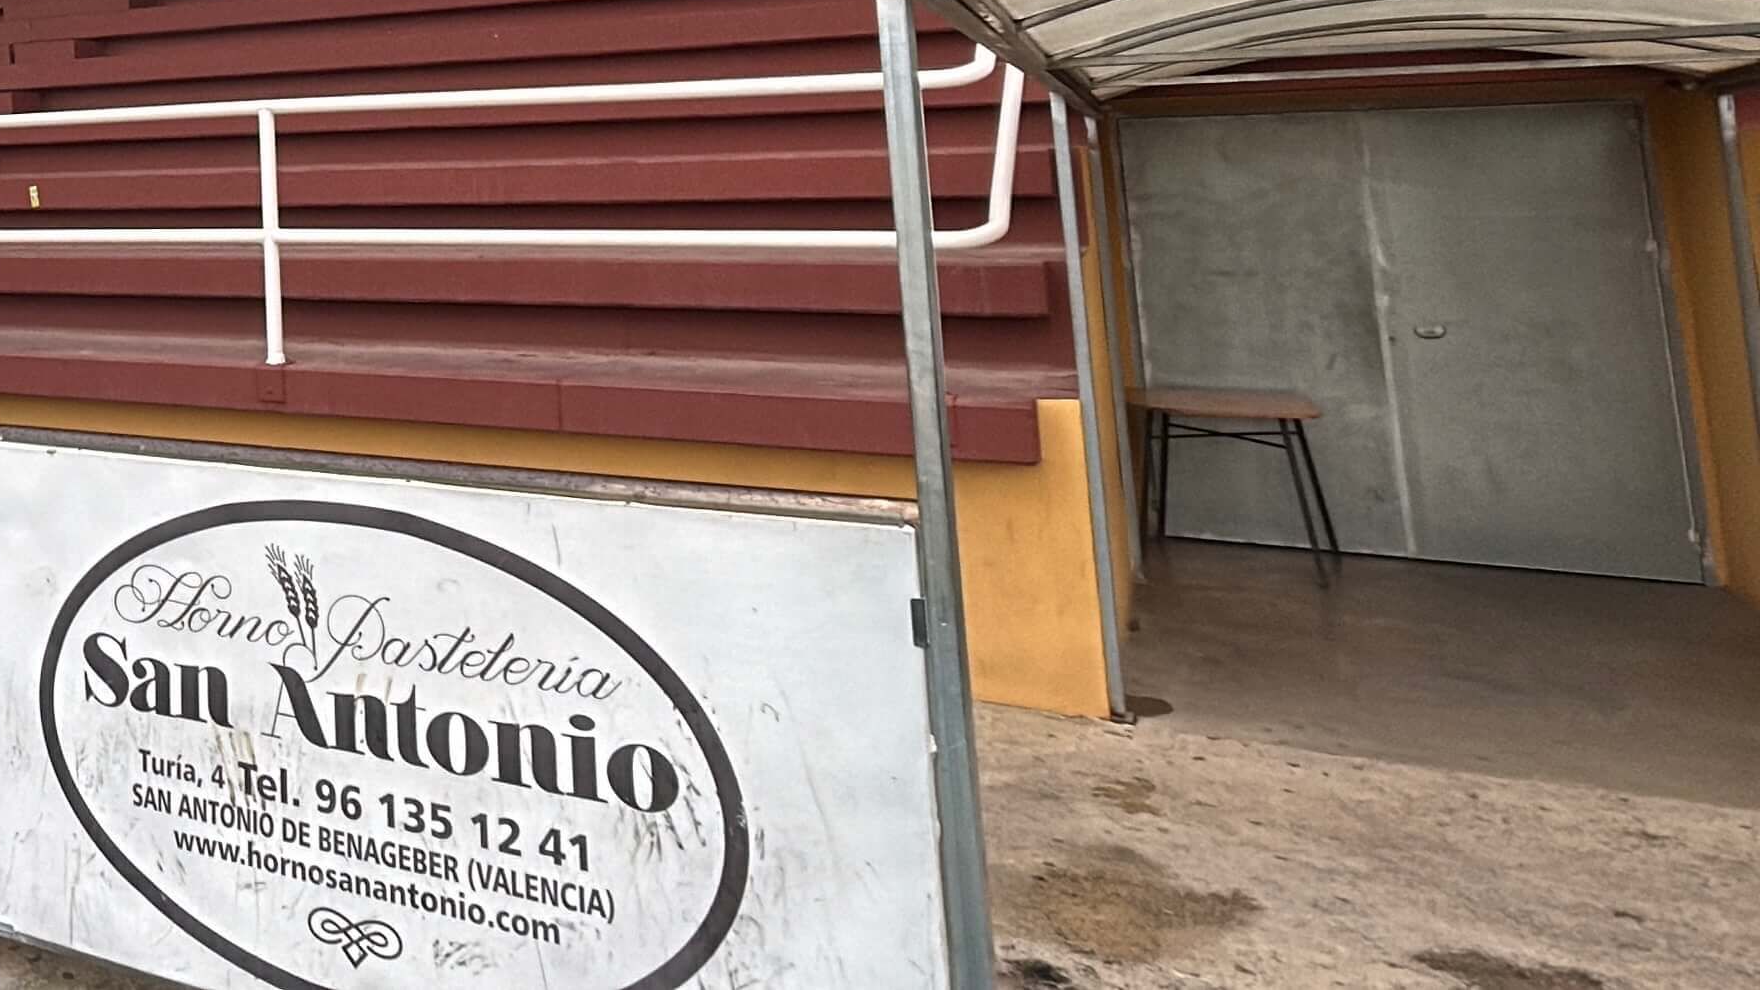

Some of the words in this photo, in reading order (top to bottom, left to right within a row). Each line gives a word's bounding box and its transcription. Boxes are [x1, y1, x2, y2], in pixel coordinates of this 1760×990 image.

[114, 563, 295, 646] Horno
[305, 594, 623, 700] Pastelería
[83, 631, 234, 729] San
[260, 660, 680, 814] Antonio
[132, 783, 172, 815] SAN
[178, 793, 275, 838] ANTONIO
[282, 817, 311, 849] DE
[319, 826, 460, 883] BENAGEBER
[468, 858, 616, 925] (VALENCIA)
[138, 748, 203, 788] Turía,
[211, 765, 225, 789] 4
[238, 761, 301, 807] Tel.
[315, 778, 363, 820] 96
[378, 792, 453, 839] 135
[471, 813, 523, 857] 12
[538, 828, 589, 872] 41
[173, 829, 561, 945] www.hornosanantonio.com
